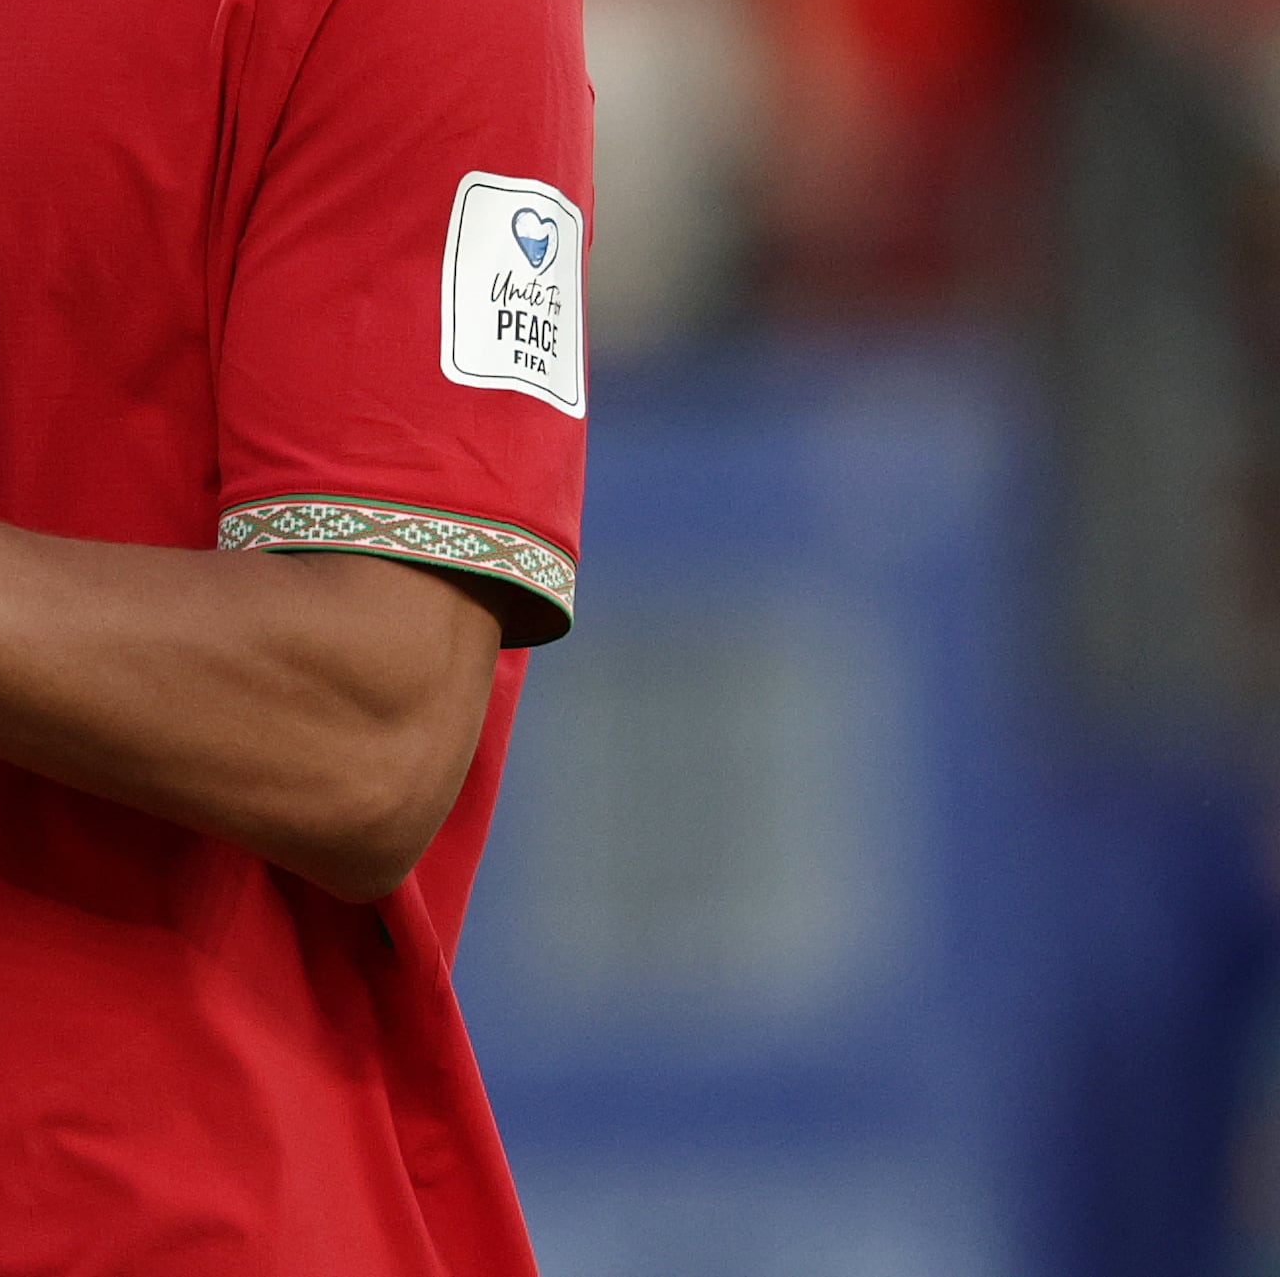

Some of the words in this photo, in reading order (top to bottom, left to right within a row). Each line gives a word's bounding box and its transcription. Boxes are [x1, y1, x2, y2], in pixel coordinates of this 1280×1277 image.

[490, 270, 545, 309] Unite
[497, 309, 558, 358] PEACE
[514, 349, 547, 375] FIFA
